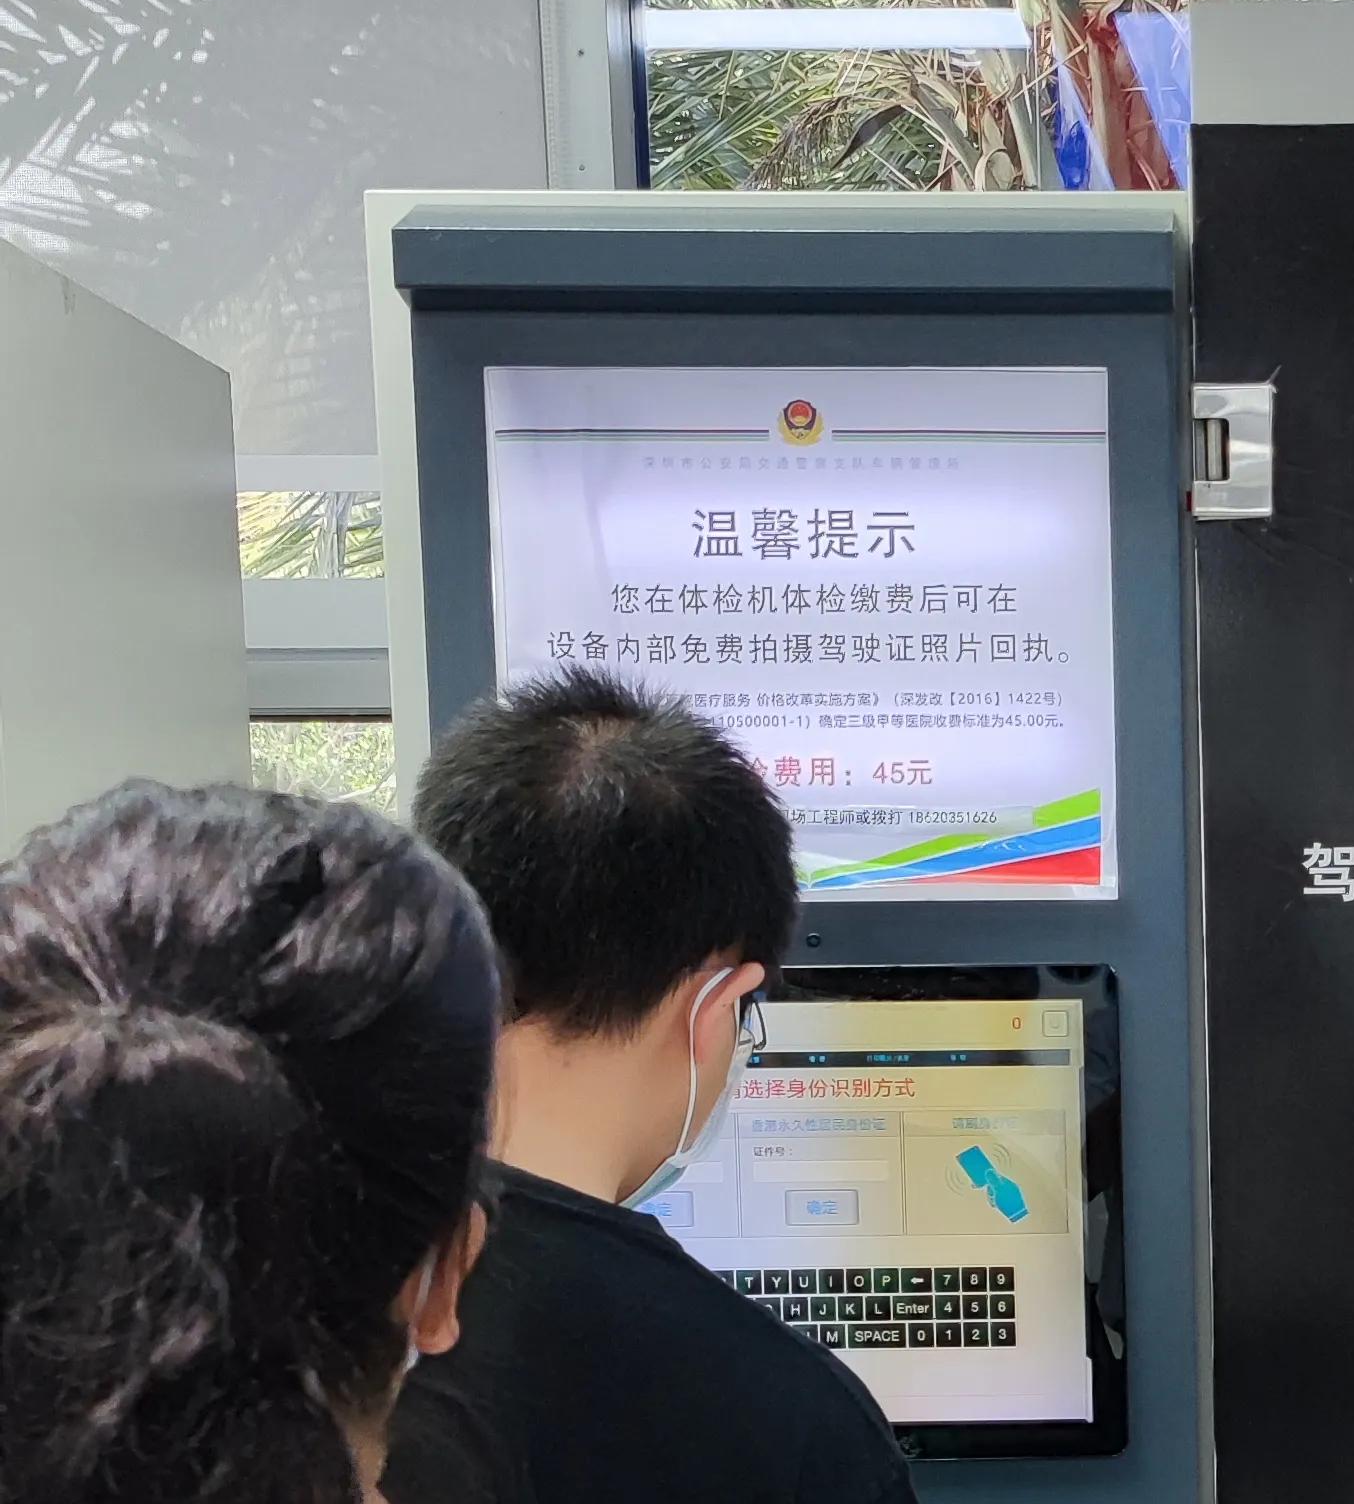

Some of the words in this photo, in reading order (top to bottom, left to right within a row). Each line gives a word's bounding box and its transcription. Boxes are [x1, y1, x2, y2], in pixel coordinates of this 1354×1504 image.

[691, 507, 917, 560] 温馨提示
[611, 582, 1018, 615] 您在体检机体检缴费后可在
[546, 630, 1072, 665] 设备内部免费拍摄驾驶证照片回执。
[733, 1077, 916, 1100] 选择身份识别方式
[744, 1276, 754, 1289] T
[771, 1276, 782, 1289] Y
[798, 1275, 809, 1288] U
[829, 1275, 833, 1288] I
[853, 1275, 865, 1288] O
[882, 1275, 891, 1287] P
[943, 1274, 952, 1286] 7
[970, 1273, 979, 1285] 8
[996, 1273, 1006, 1285] 9
[790, 1303, 801, 1317] H
[818, 1303, 827, 1316] J
[845, 1303, 856, 1315] K
[874, 1303, 883, 1315] L
[896, 1302, 930, 1314] Enter
[943, 1301, 953, 1313] 4
[971, 1301, 979, 1313] 5
[997, 1300, 1007, 1313] 6
[826, 1330, 839, 1343] M
[854, 1330, 900, 1343] SPACE
[917, 1329, 926, 1341] 0
[945, 1329, 952, 1341] 1
[971, 1328, 981, 1341] 2
[998, 1328, 1007, 1340] 3
